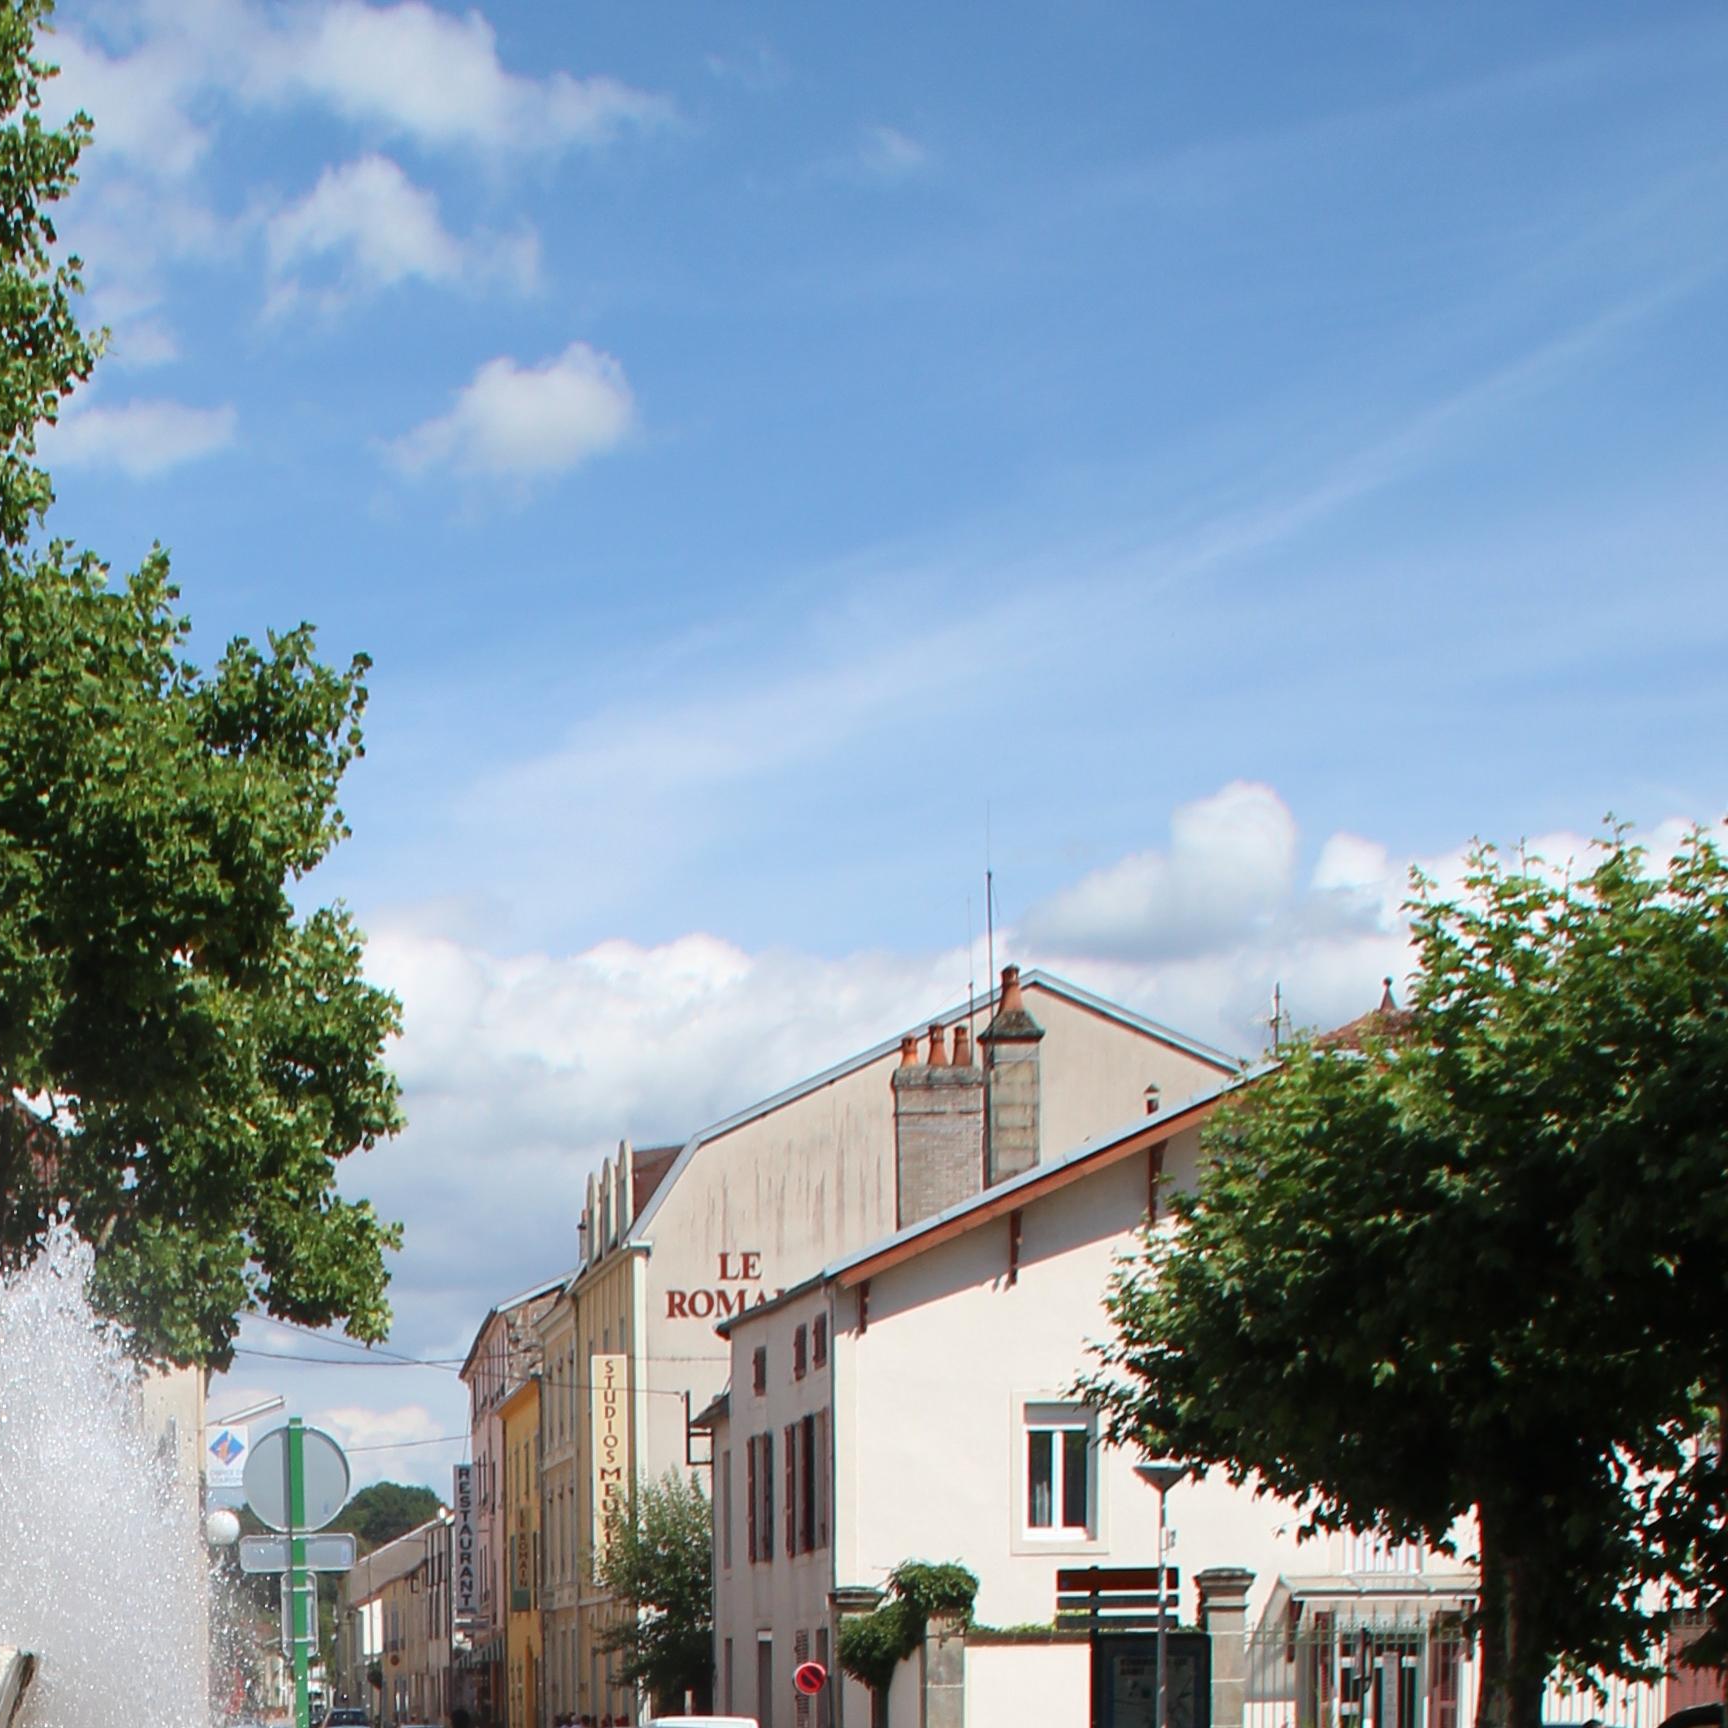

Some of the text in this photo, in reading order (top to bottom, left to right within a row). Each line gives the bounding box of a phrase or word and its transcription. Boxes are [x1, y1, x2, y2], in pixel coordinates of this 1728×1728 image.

[718, 1251, 762, 1281] LE
[603, 1360, 619, 1463] STUDIOS
[458, 1467, 474, 1607] RESTAURANT
